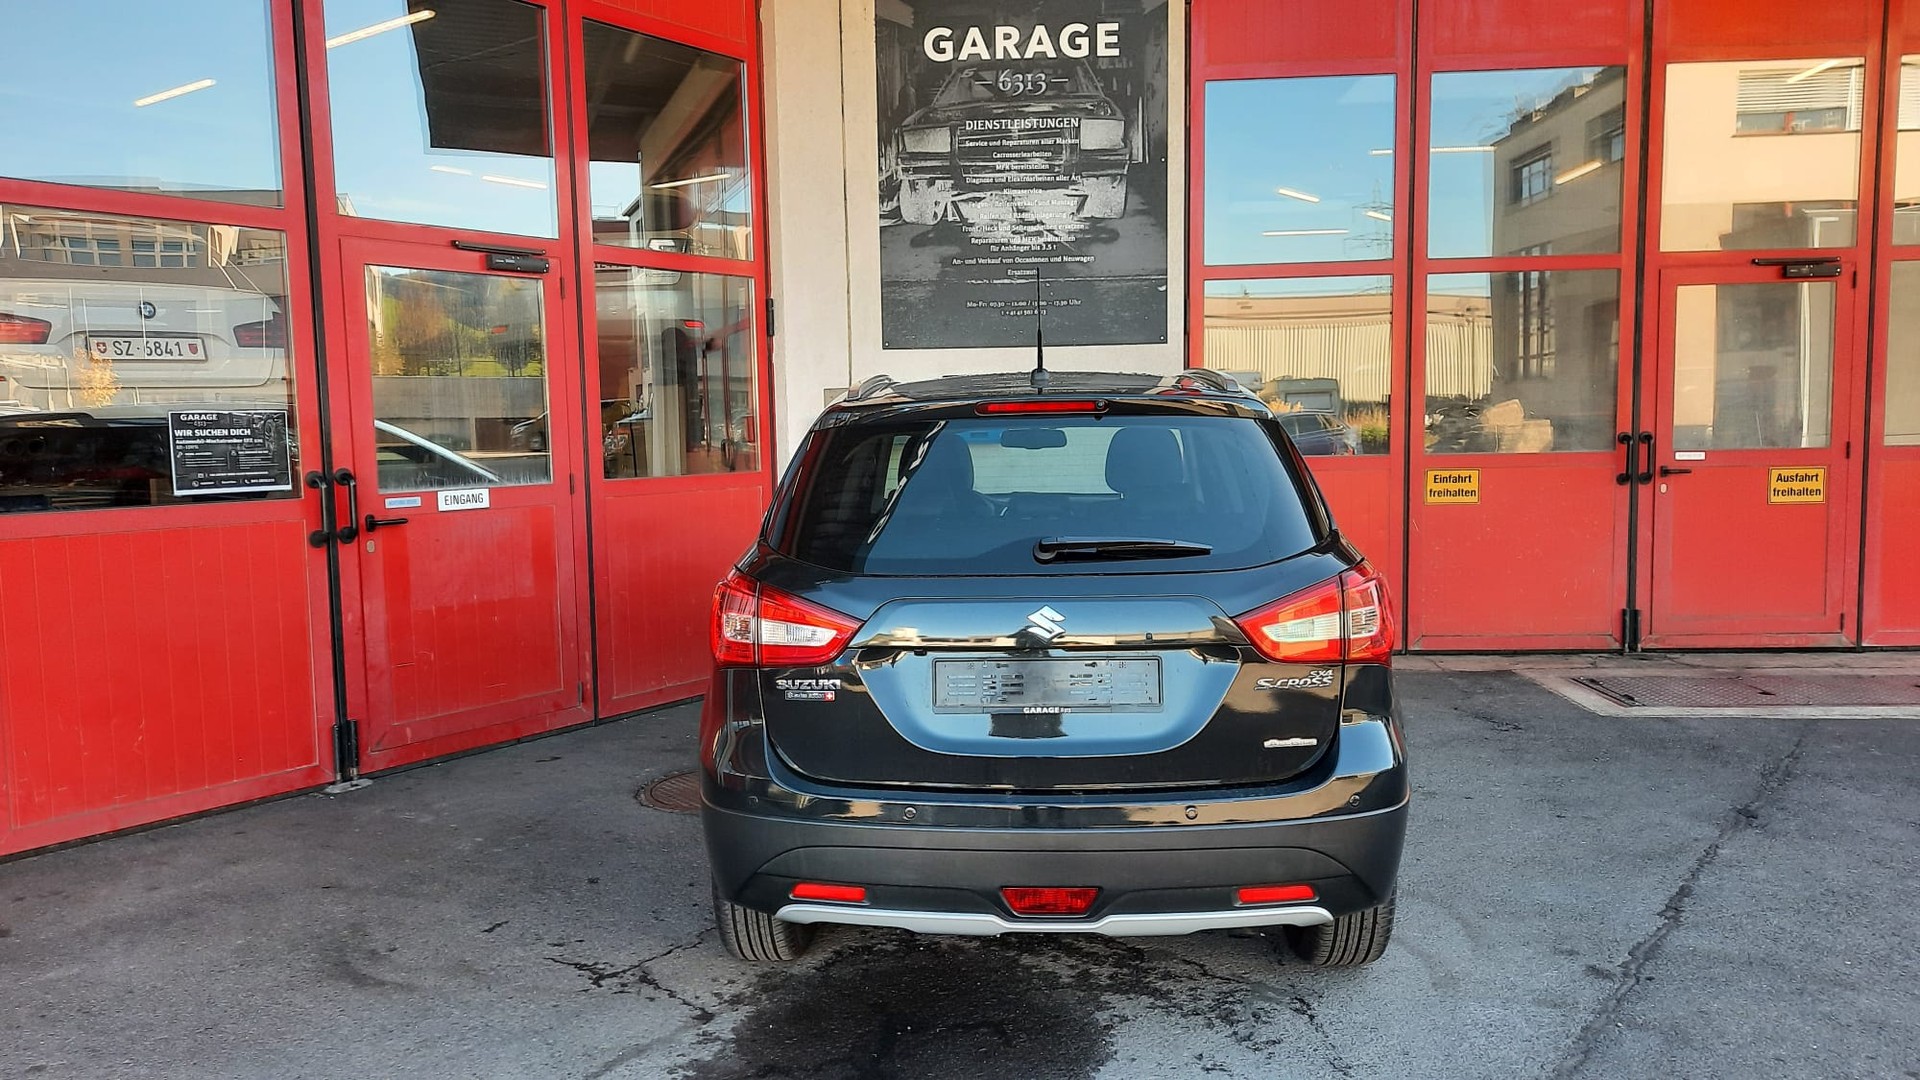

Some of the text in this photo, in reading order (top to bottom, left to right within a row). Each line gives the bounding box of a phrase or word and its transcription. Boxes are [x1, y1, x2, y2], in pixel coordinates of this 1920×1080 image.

[924, 22, 1120, 62] GARAGE
[998, 69, 1047, 96] 6313
[965, 117, 1079, 130] DIENSTLEISTUNGEN
[1002, 138, 1040, 148] Reparaturen
[1001, 245, 1031, 253] Anhänger
[1015, 256, 1048, 264] Occasionen
[1063, 255, 1095, 263] Neuwagen
[174, 428, 251, 437] WIR SUCHEN DICH
[1434, 474, 1472, 484] Einfahrt
[1776, 473, 1819, 482] Ausfahrt
[1429, 488, 1477, 497] freihalten
[1773, 487, 1821, 496] freihalten
[444, 493, 484, 506] EINGANG
[776, 679, 841, 690] SUZUKI
